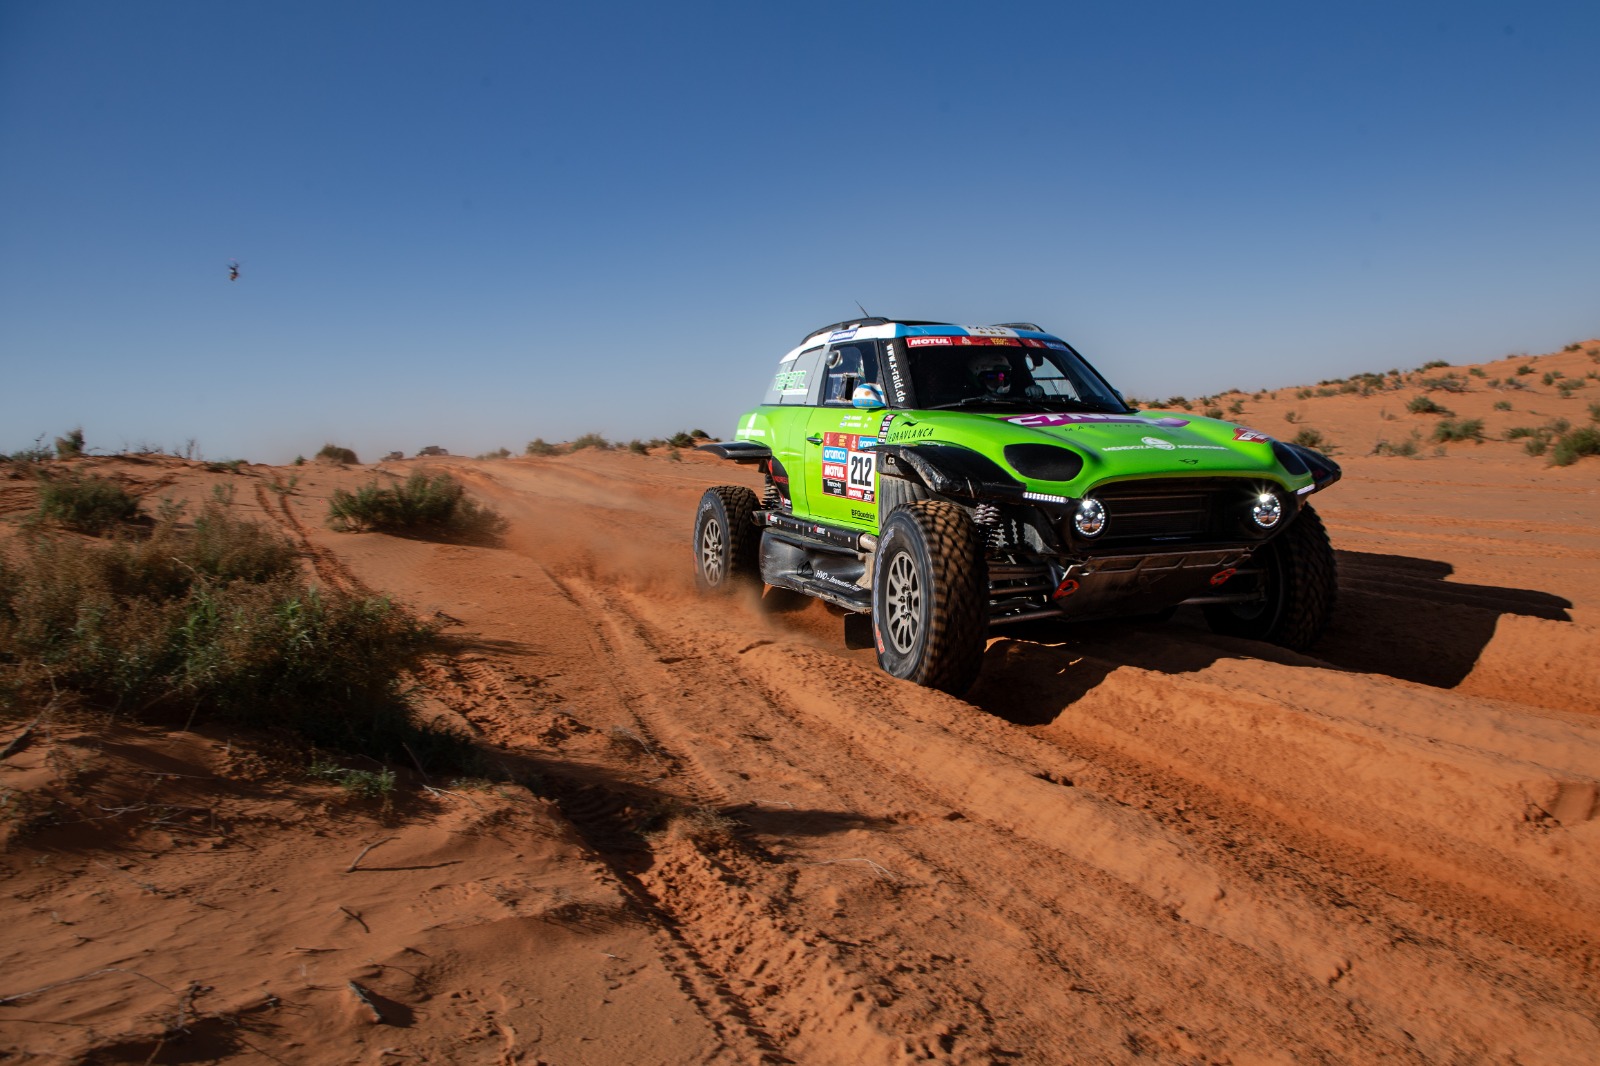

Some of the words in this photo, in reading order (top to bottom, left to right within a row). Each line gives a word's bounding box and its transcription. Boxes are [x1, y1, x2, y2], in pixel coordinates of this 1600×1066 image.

[886, 343, 905, 403] www.x-raid.de
[825, 449, 846, 460] aramco
[824, 465, 845, 478] MOTUL
[851, 456, 872, 487] 212
[848, 489, 863, 498] MOTUL
[851, 509, 875, 520] BFGoodrich
